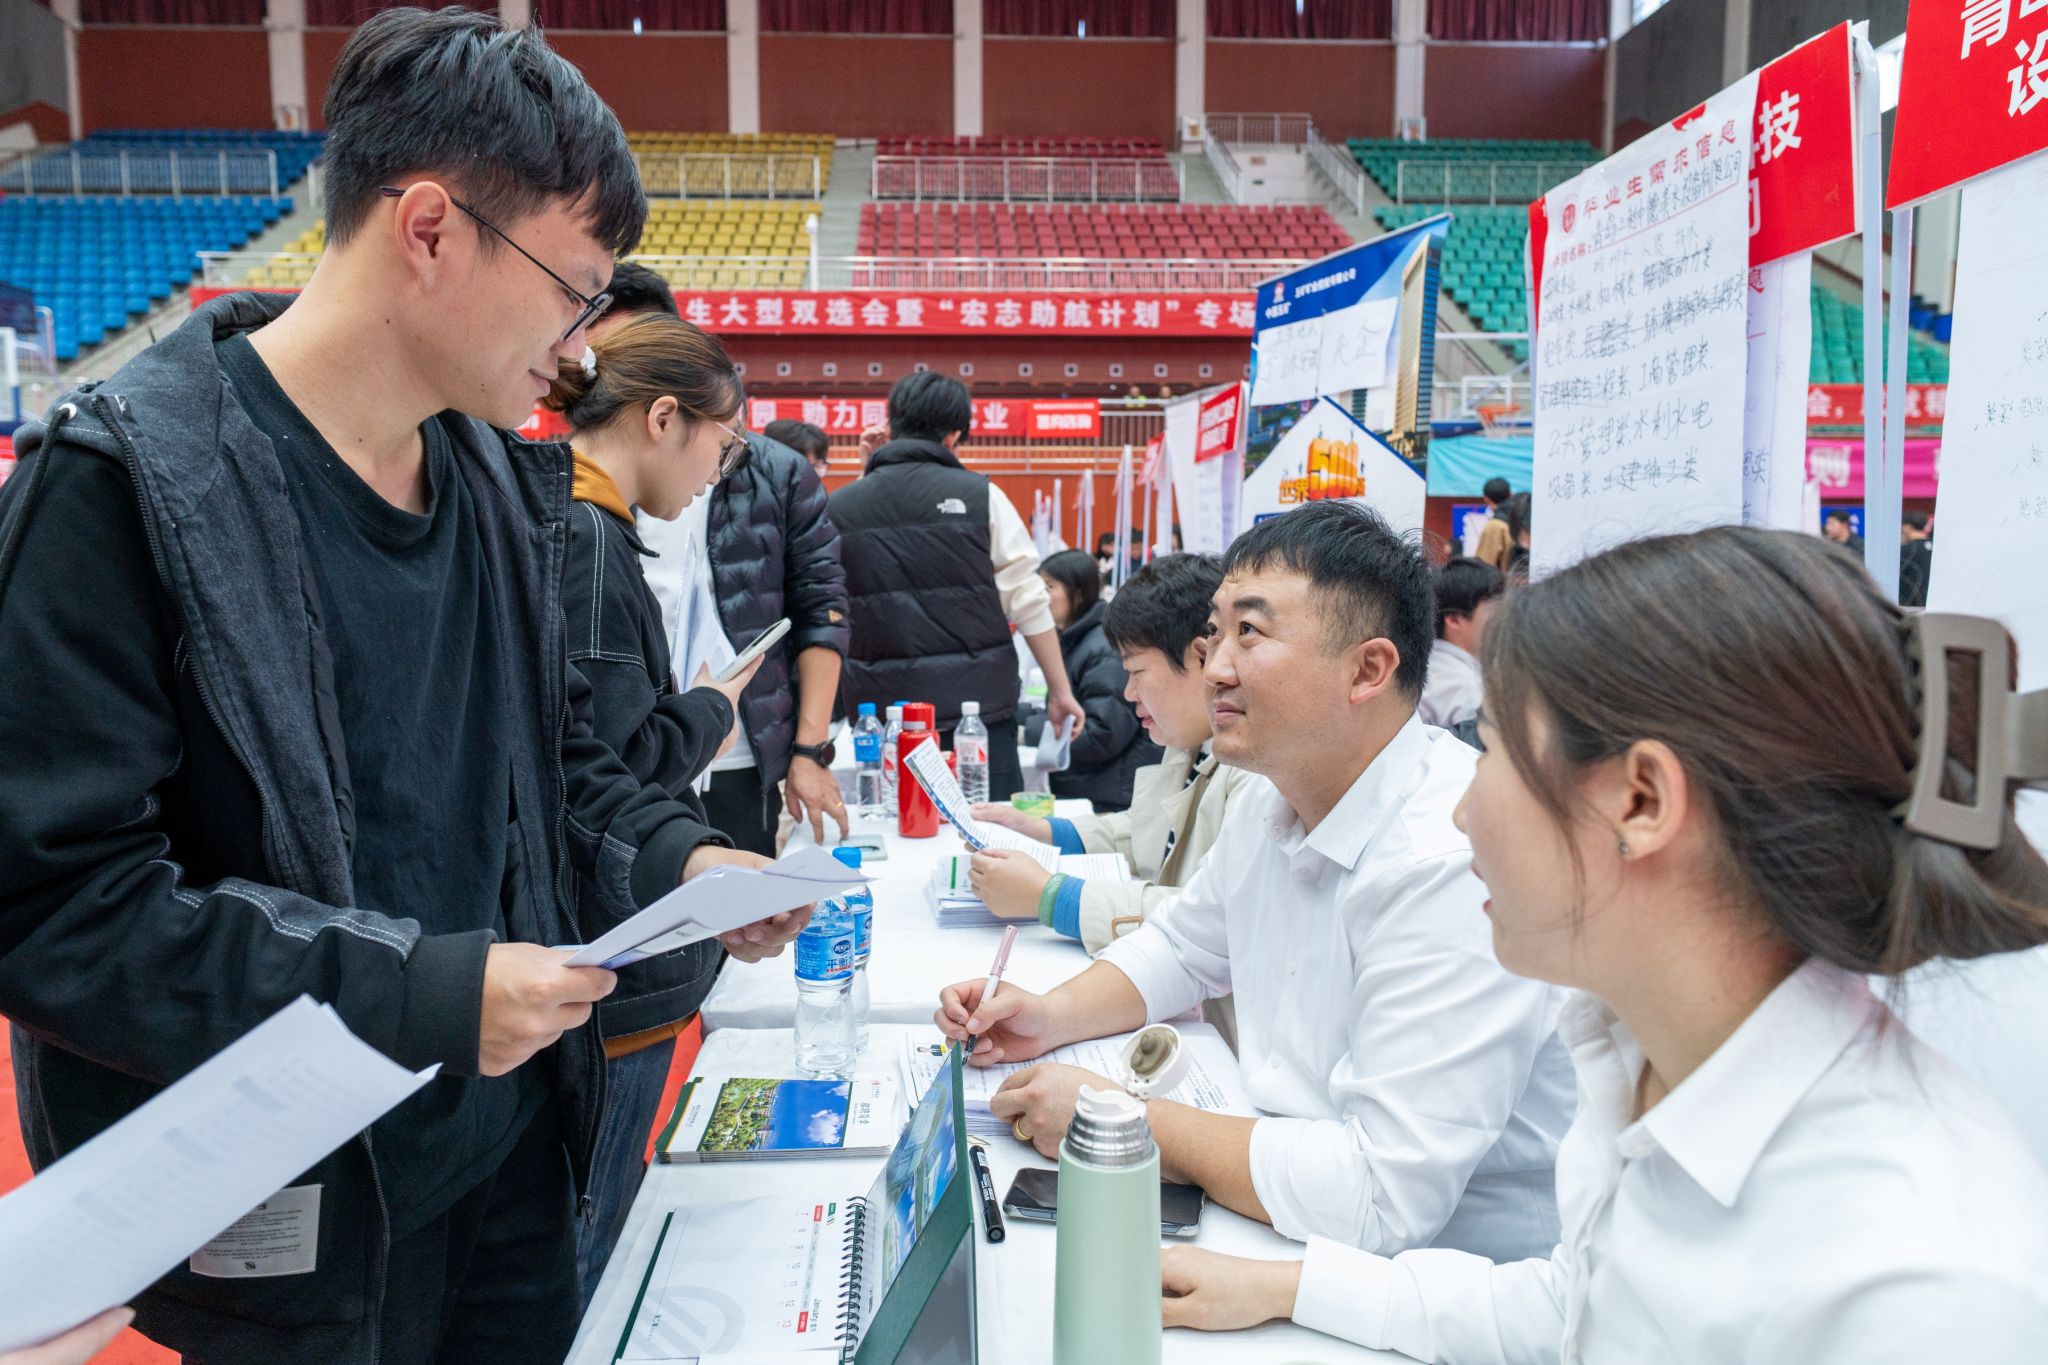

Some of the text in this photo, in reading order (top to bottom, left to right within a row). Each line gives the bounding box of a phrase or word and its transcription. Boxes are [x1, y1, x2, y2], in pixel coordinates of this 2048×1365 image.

[1583, 119, 1737, 217] 毕业生需求信息
[1749, 90, 1802, 170] 技
[810, 1298, 823, 1323] January
